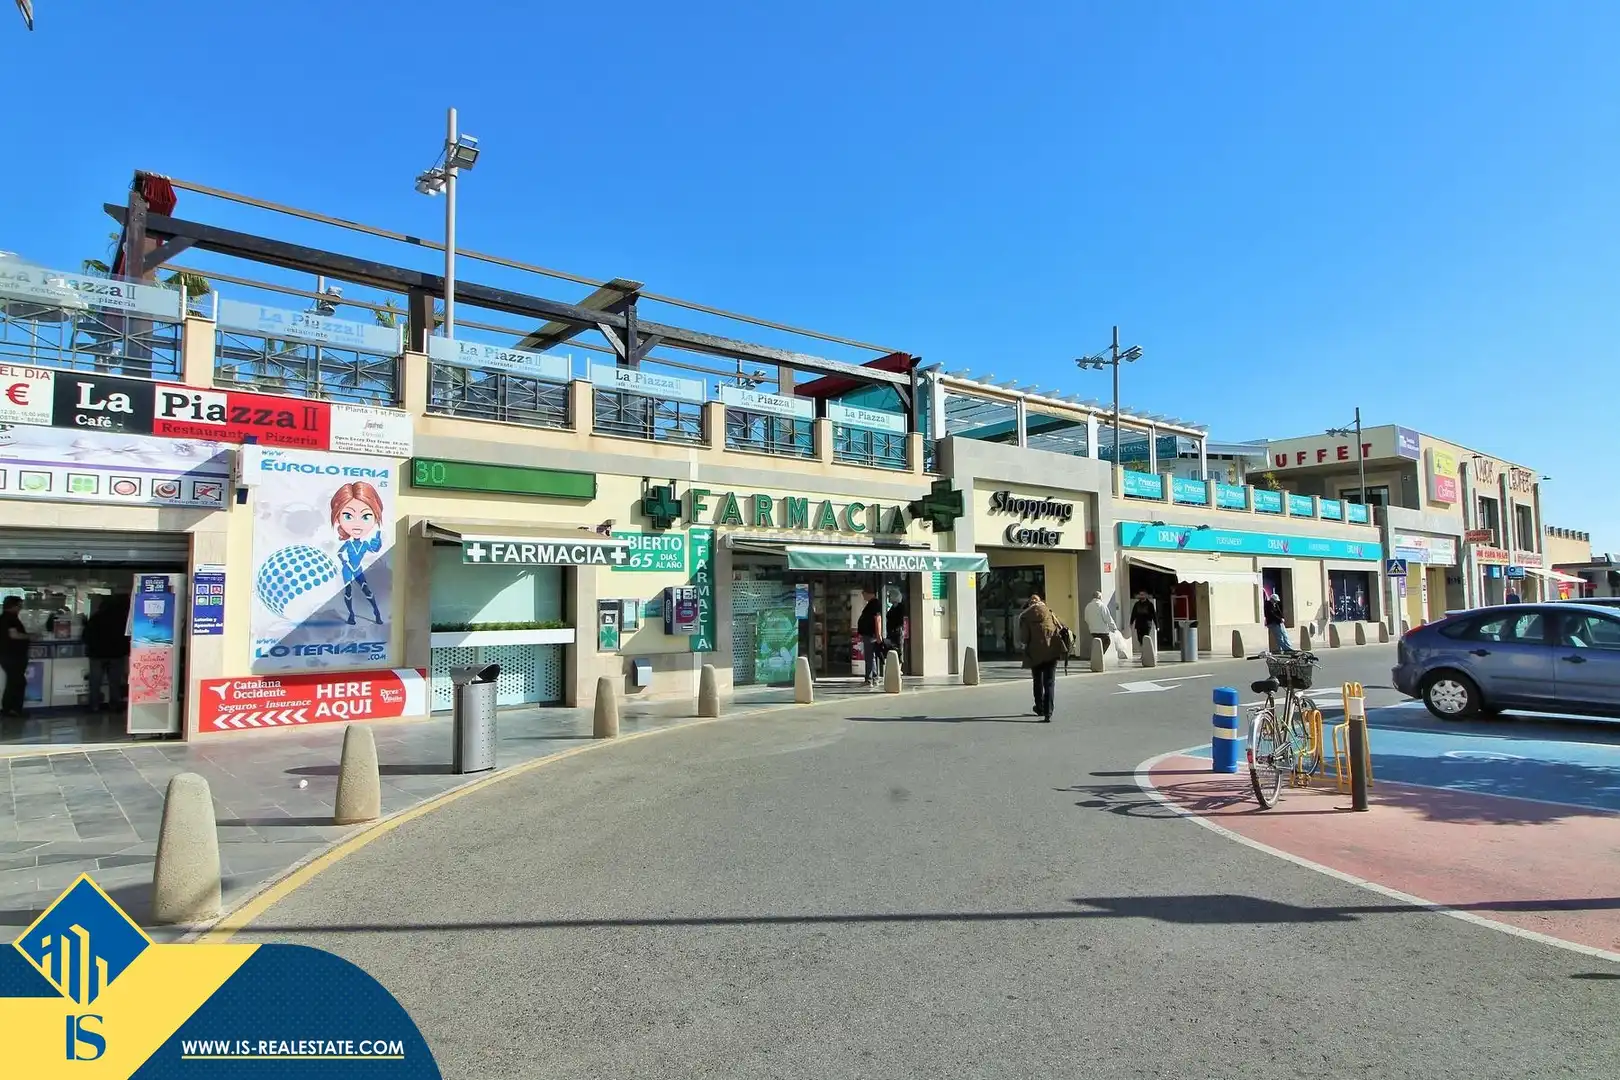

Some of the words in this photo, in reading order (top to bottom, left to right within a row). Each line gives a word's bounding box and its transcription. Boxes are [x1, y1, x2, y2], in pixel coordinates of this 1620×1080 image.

[484, 347, 532, 365] Piazza
[0, 366, 19, 377] EL
[615, 370, 631, 382] La
[635, 372, 675, 389] Piazza
[75, 381, 134, 414] La
[161, 392, 297, 428] Piazza
[757, 393, 790, 408] Piazza
[844, 408, 855, 419] La
[858, 410, 885, 423] Piazza
[75, 414, 112, 428] Café
[265, 432, 318, 445] Pizzeria
[1271, 443, 1372, 468] UFFET
[261, 458, 389, 479] EUROLOTERIA
[690, 488, 909, 535] FARMACIA
[991, 491, 1073, 522] Shopping
[617, 535, 683, 551] BIERTO
[1004, 523, 1063, 547] Center
[491, 543, 607, 565] FARMACIA
[862, 555, 928, 571] FARMACIA
[666, 560, 682, 568] AÑO
[695, 545, 712, 651] FARMACIA
[233, 680, 281, 690] Catalana
[233, 689, 287, 699] Occidente
[316, 681, 372, 700] HERE
[217, 703, 257, 713] Seguros
[265, 699, 312, 709] Insurance
[314, 699, 373, 719] AQUI
